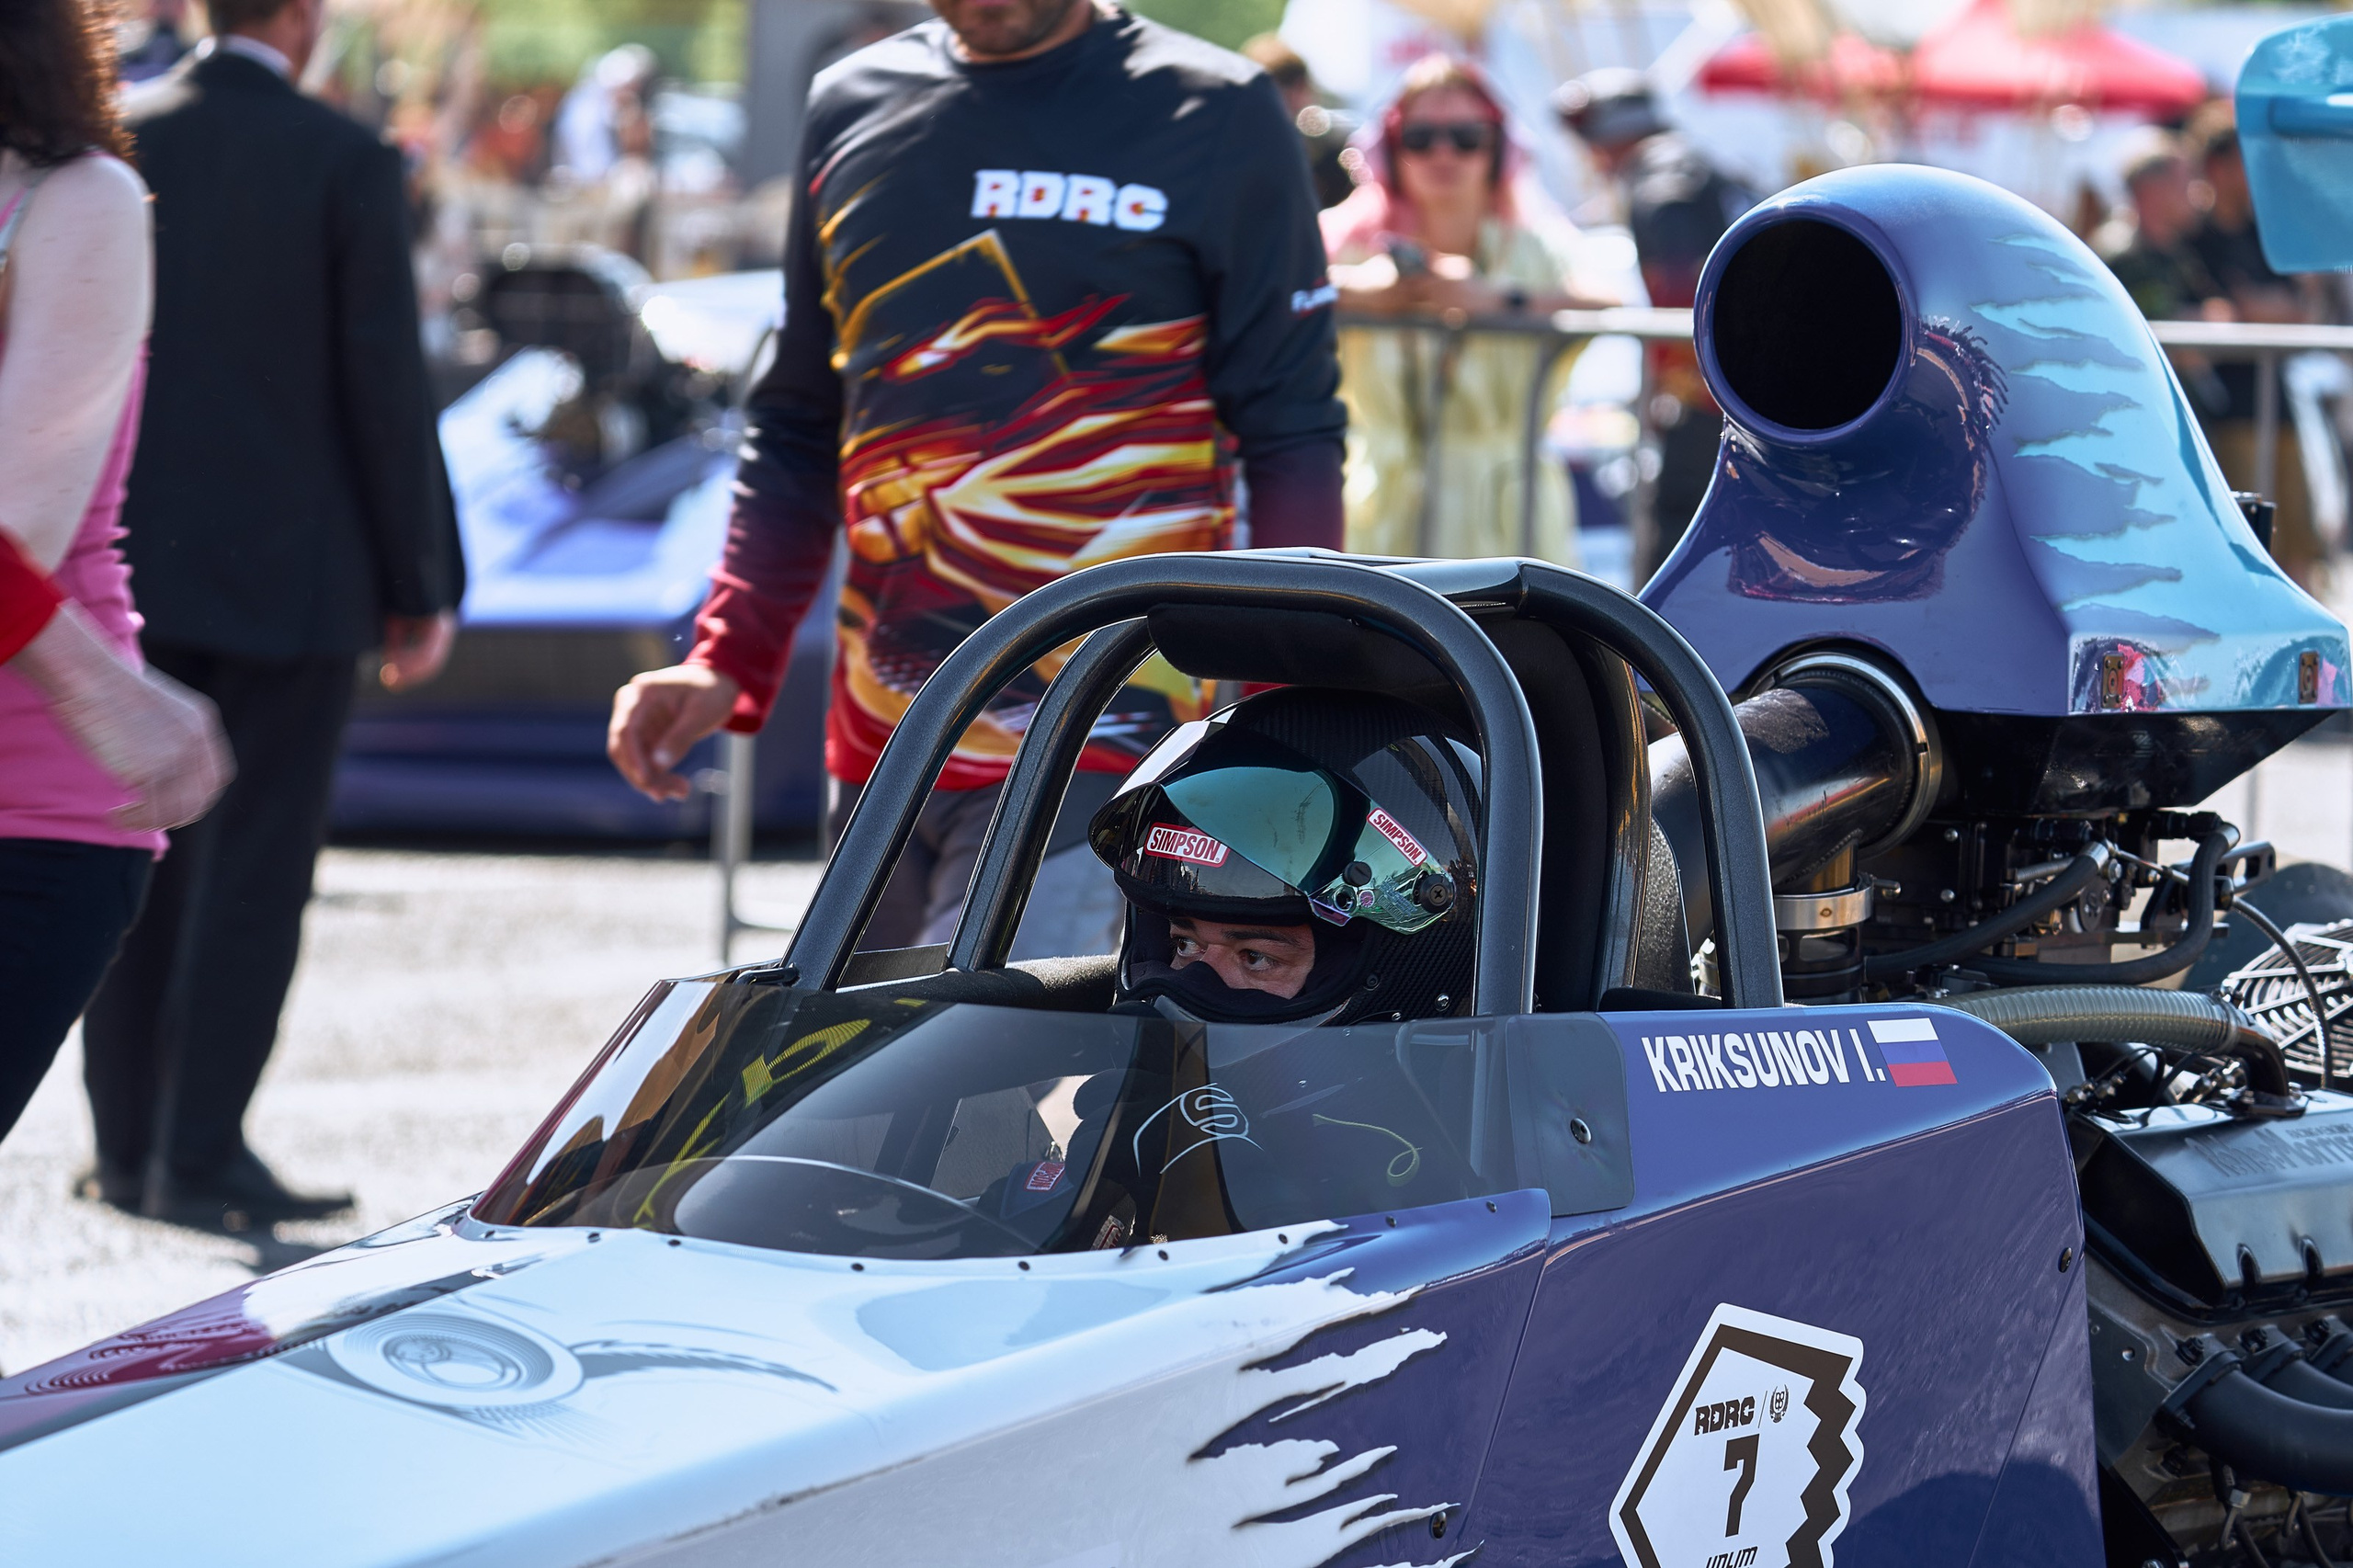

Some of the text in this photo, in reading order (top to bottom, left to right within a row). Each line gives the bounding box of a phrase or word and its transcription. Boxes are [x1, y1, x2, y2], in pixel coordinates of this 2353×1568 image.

[971, 168, 1168, 232] RDRC
[1641, 1028, 1886, 1093] KRIKSUNOV I.
[1694, 1395, 1756, 1436] RDRC
[1723, 1433, 1760, 1538] 7
